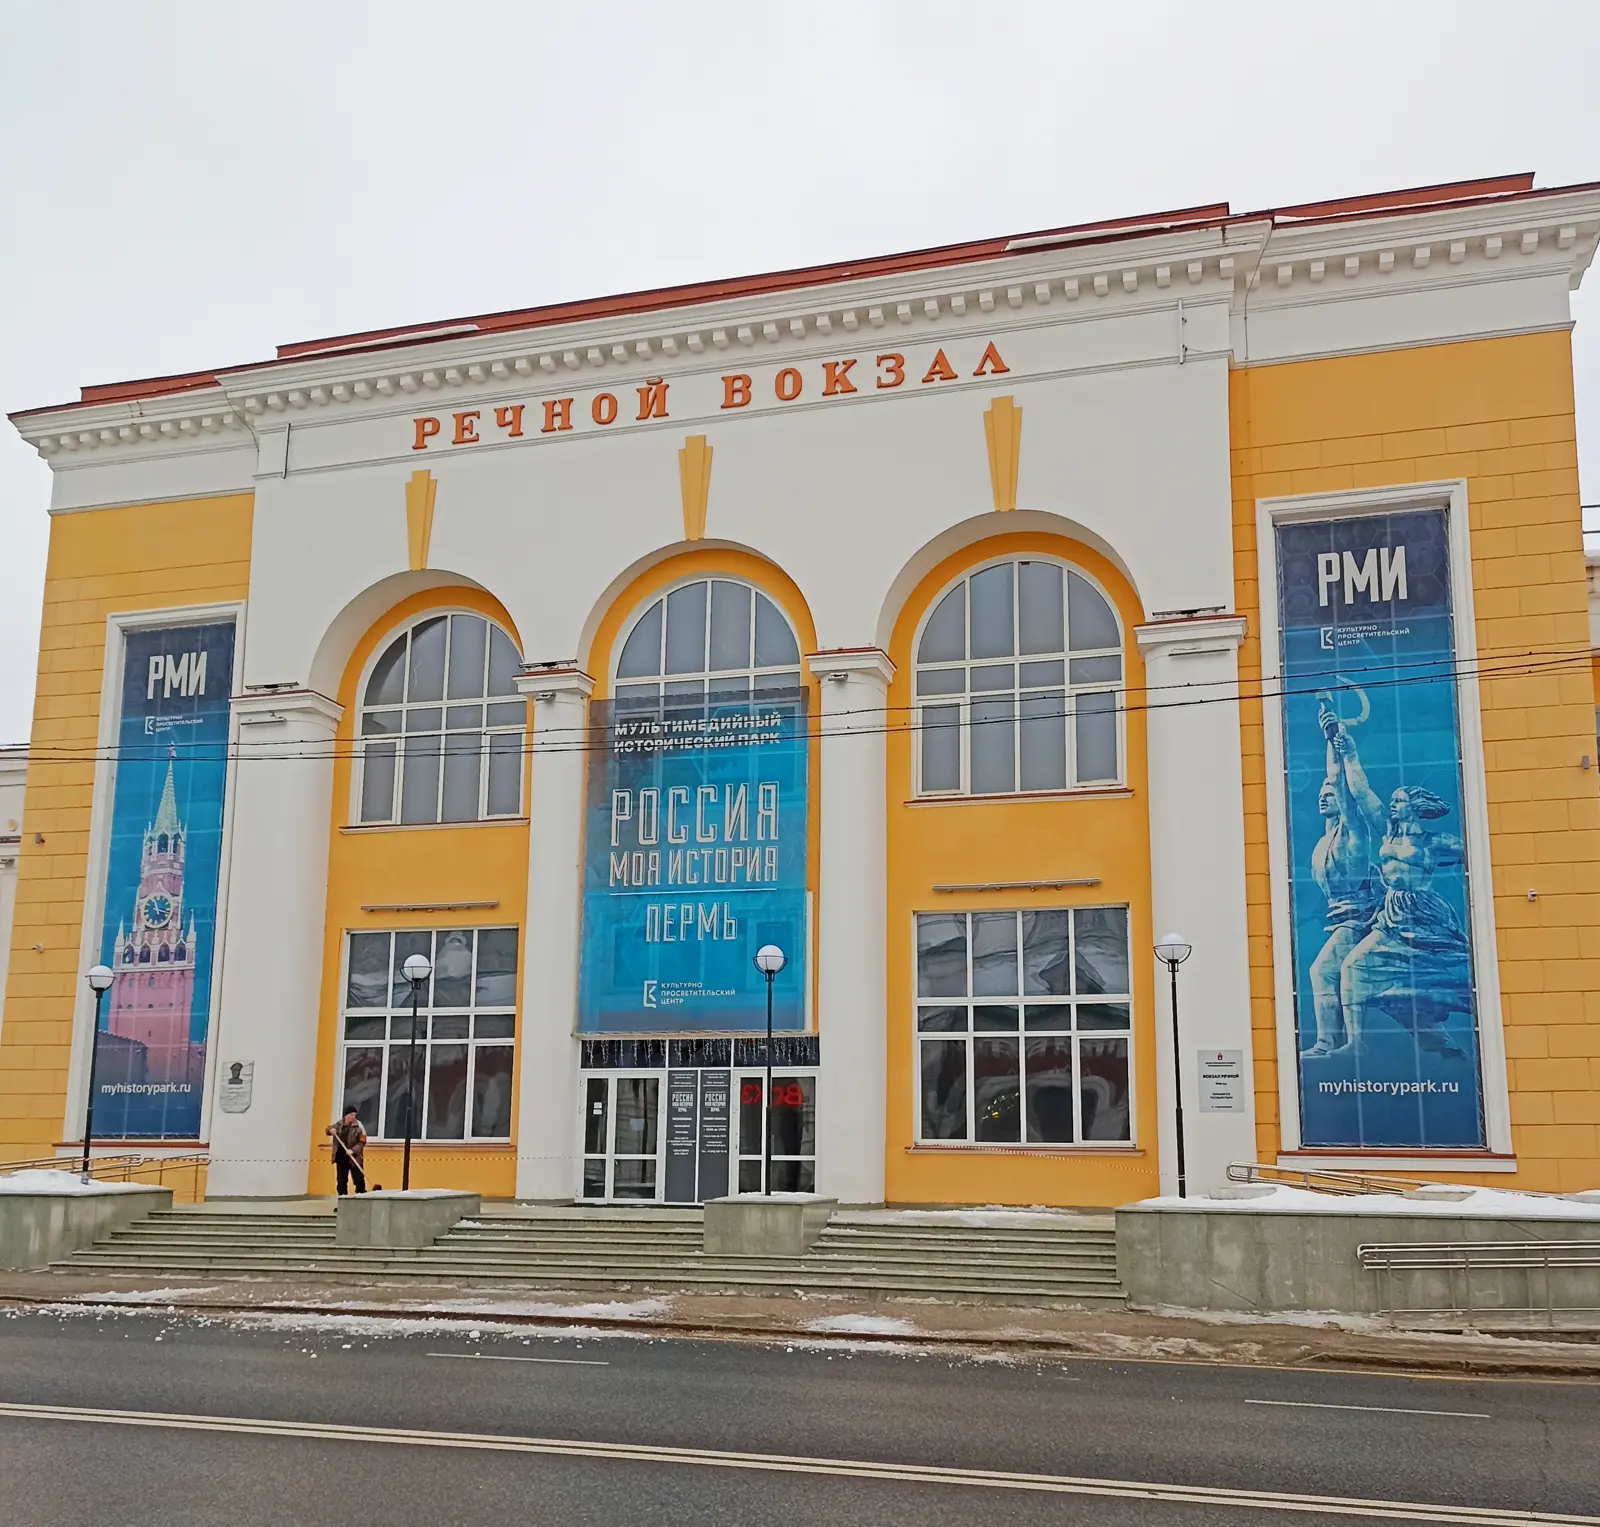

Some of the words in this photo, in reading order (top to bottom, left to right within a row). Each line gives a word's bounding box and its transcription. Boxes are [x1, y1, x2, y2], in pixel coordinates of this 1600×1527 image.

[412, 376, 670, 450] РЕЧНОЙ
[720, 341, 1011, 410] ВОКЗАЛ
[1317, 545, 1408, 607] РМИ
[1337, 627, 1410, 639] ПРОСВЕТИТЕЛЬСКИЙ
[147, 651, 208, 700] РМИ
[614, 711, 781, 736] МУЛЬТИМЕДИЙНЫЙ
[614, 732, 735, 753] ИСТОРИЧЕСКИЙ
[738, 732, 780, 746] ПАРК
[610, 781, 780, 847] РОССИЯ
[609, 851, 661, 887] МОЯ
[668, 845, 779, 885] ИСТОРИЯ
[645, 902, 738, 942] ПЕРМЬ
[661, 988, 736, 997] ПРОСВЕТИТЕЛЬСКИЙ
[101, 1082, 191, 1096] myhistorypark.ru
[1319, 1079, 1459, 1096] myhistorypark.ru
